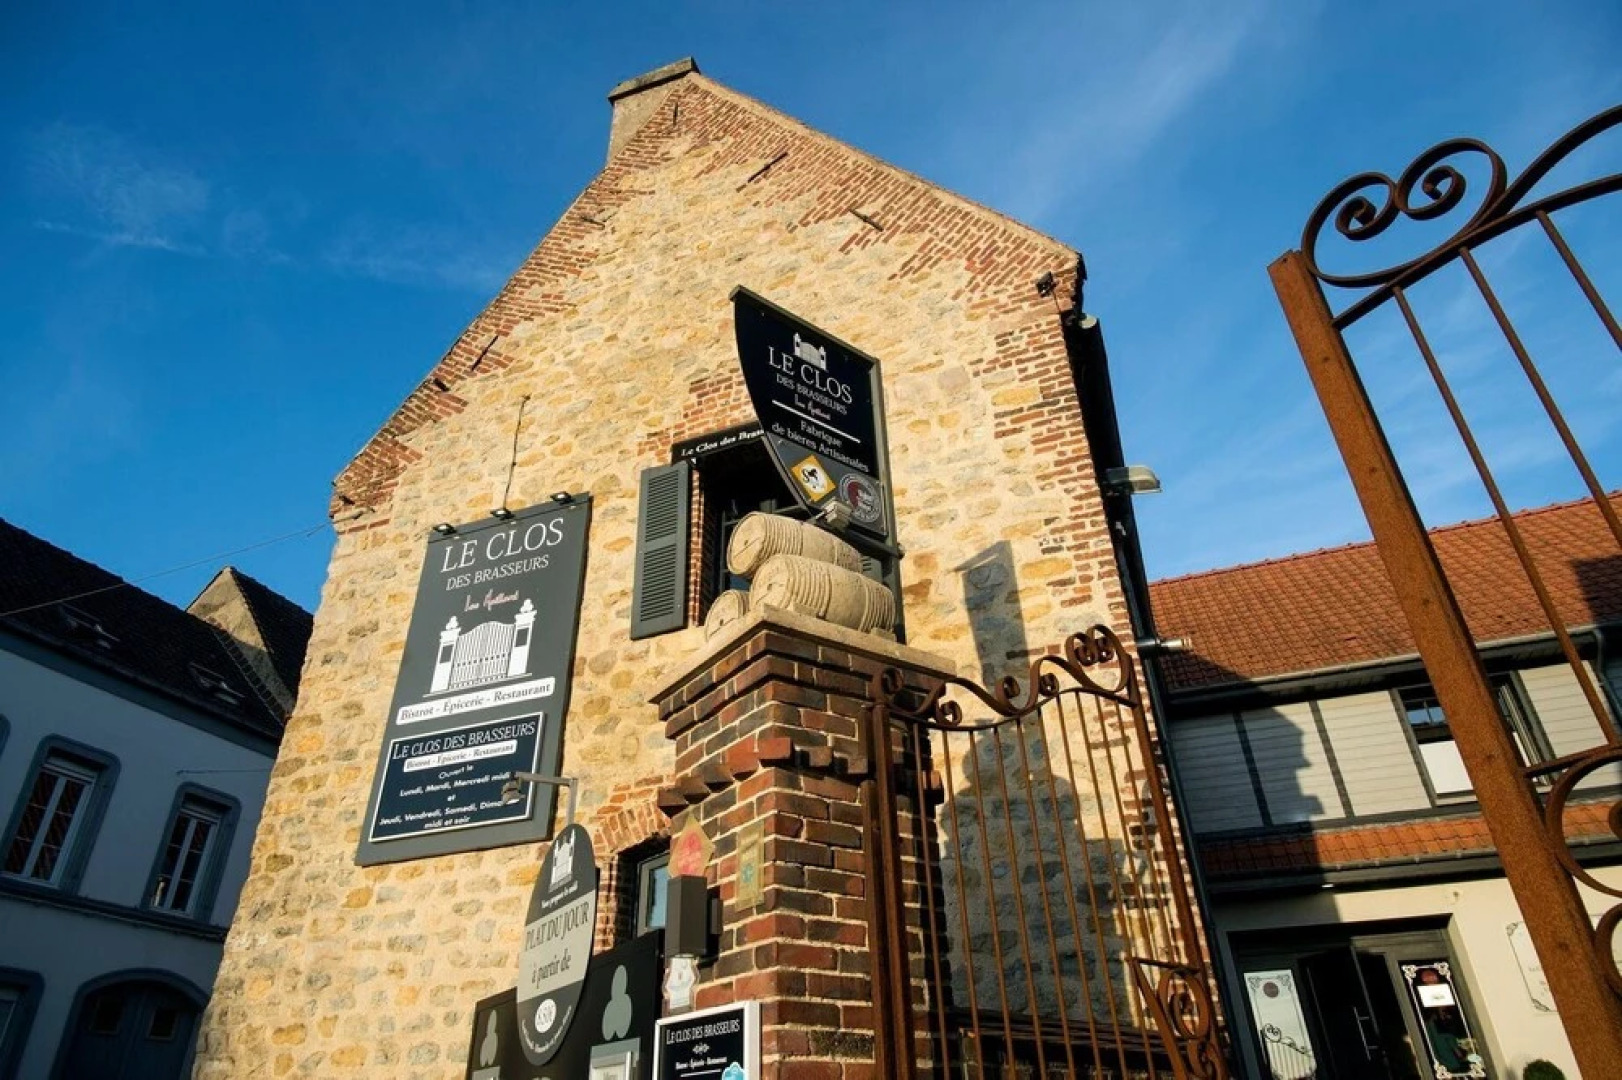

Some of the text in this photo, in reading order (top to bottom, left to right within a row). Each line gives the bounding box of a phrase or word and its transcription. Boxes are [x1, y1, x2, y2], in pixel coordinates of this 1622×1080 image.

[768, 346, 852, 404] LE CLOS
[776, 373, 795, 390] DES
[796, 383, 848, 415] BRASSEURS
[696, 442, 718, 452] Clos
[720, 436, 736, 446] des
[771, 423, 785, 435] de
[800, 420, 842, 447] Fabrique
[440, 517, 564, 573] LE CLOS
[445, 554, 549, 591] DES BRASSEURS
[401, 707, 434, 721] Bistrot
[494, 683, 551, 702] Restaurant
[392, 721, 536, 760] LE CLOS DES BRASSEURS
[438, 766, 465, 779] Ouvert
[453, 775, 490, 787] Mercredi
[525, 901, 589, 951] PLAT DU JOUR
[537, 954, 560, 989] partir
[560, 948, 571, 971] de
[676, 1027, 692, 1042] CLOS
[692, 1025, 702, 1039] DES
[704, 1019, 740, 1037] BRASSEURS
